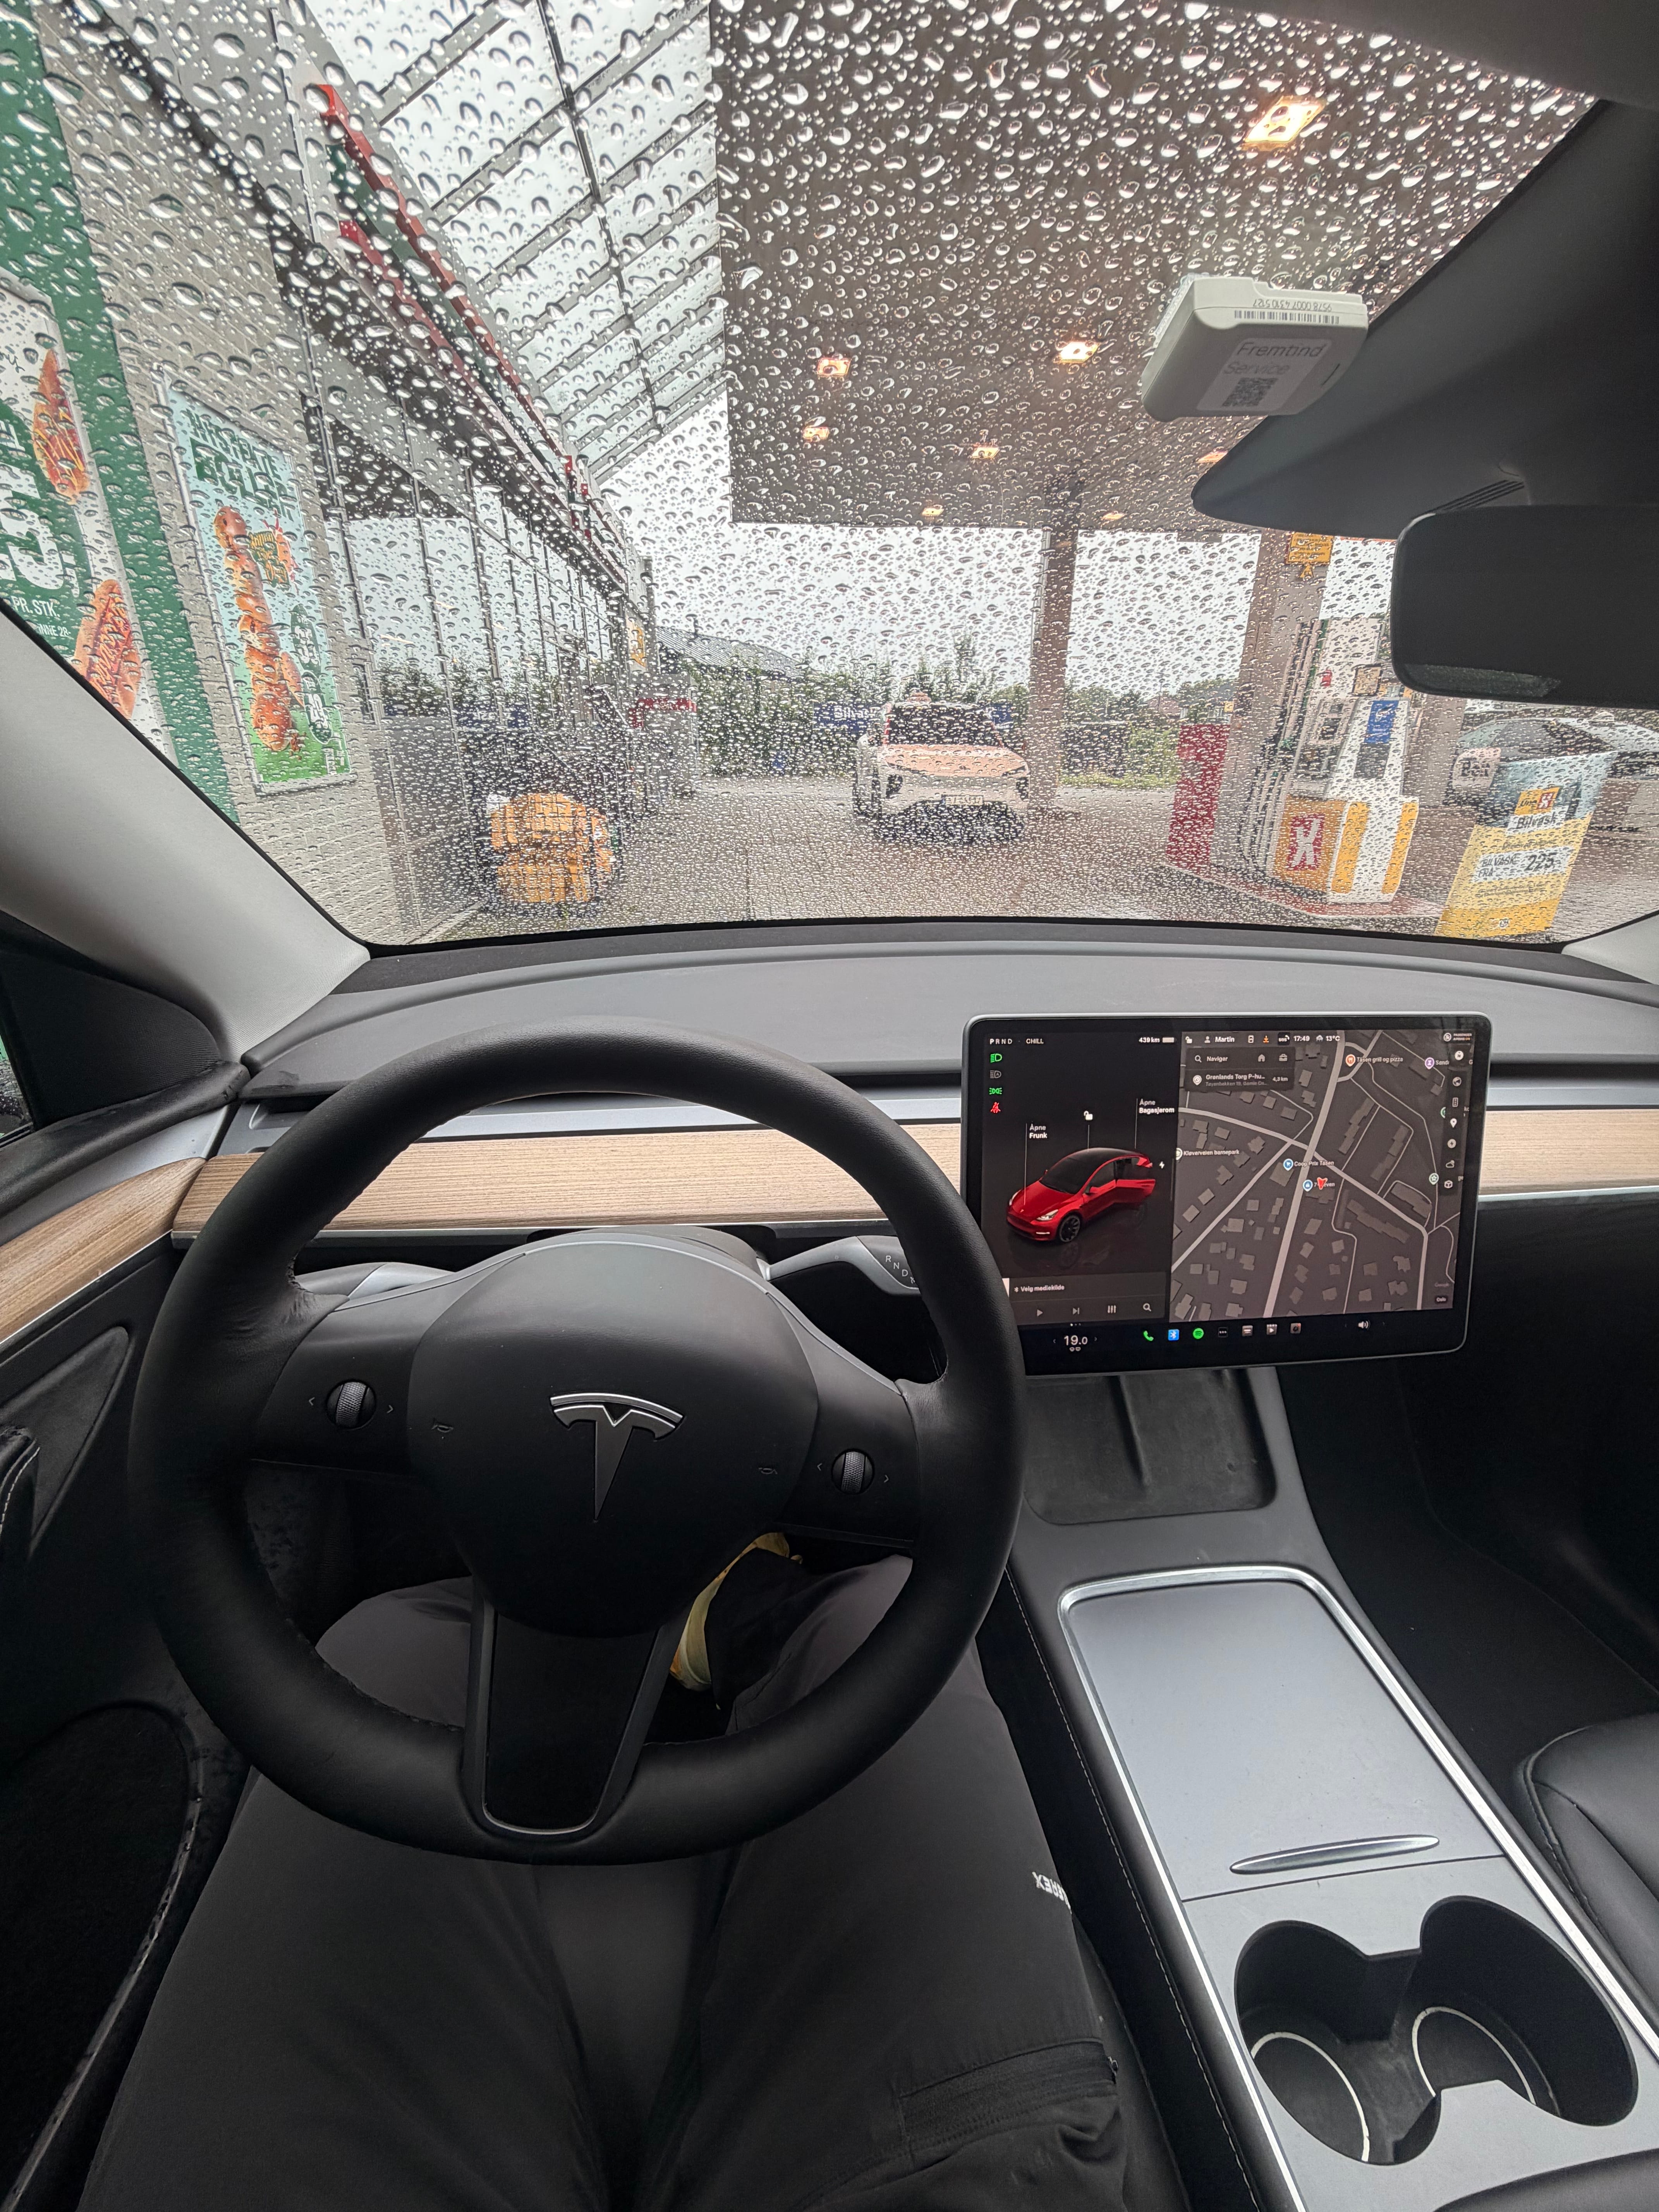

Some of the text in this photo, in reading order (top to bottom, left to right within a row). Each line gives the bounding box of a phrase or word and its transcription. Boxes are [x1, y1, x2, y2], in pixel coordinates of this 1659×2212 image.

[1252, 298, 1332, 313] 9578 0007 4310 5127
[1237, 342, 1328, 357] Fremtind
[11, 596, 60, 618] PR. STK.
[1063, 1335, 1088, 1346] 19.0
